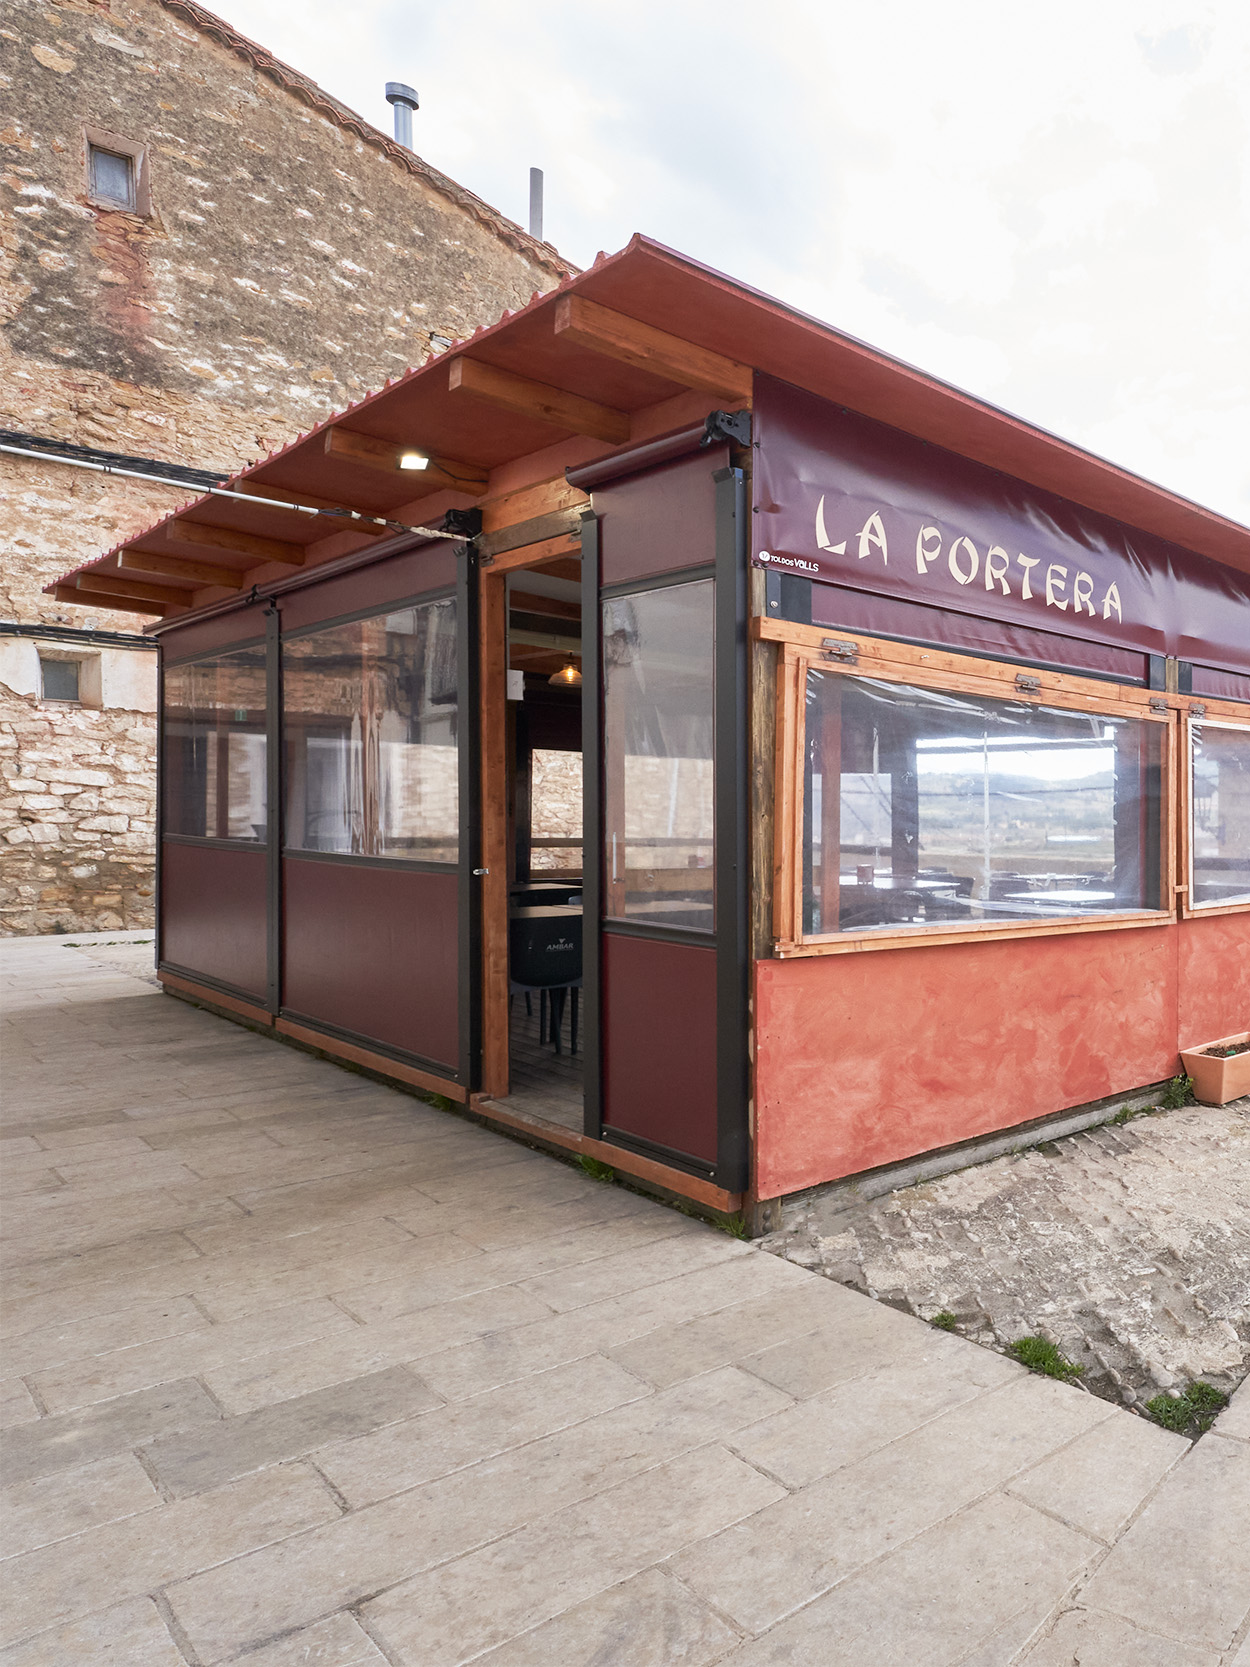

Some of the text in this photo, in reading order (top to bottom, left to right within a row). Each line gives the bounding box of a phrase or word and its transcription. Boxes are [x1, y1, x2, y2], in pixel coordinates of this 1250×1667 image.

[770, 555, 794, 567] TOLDOS
[815, 494, 1123, 625] LA PORTERA
[546, 943, 574, 951] AMBAR
